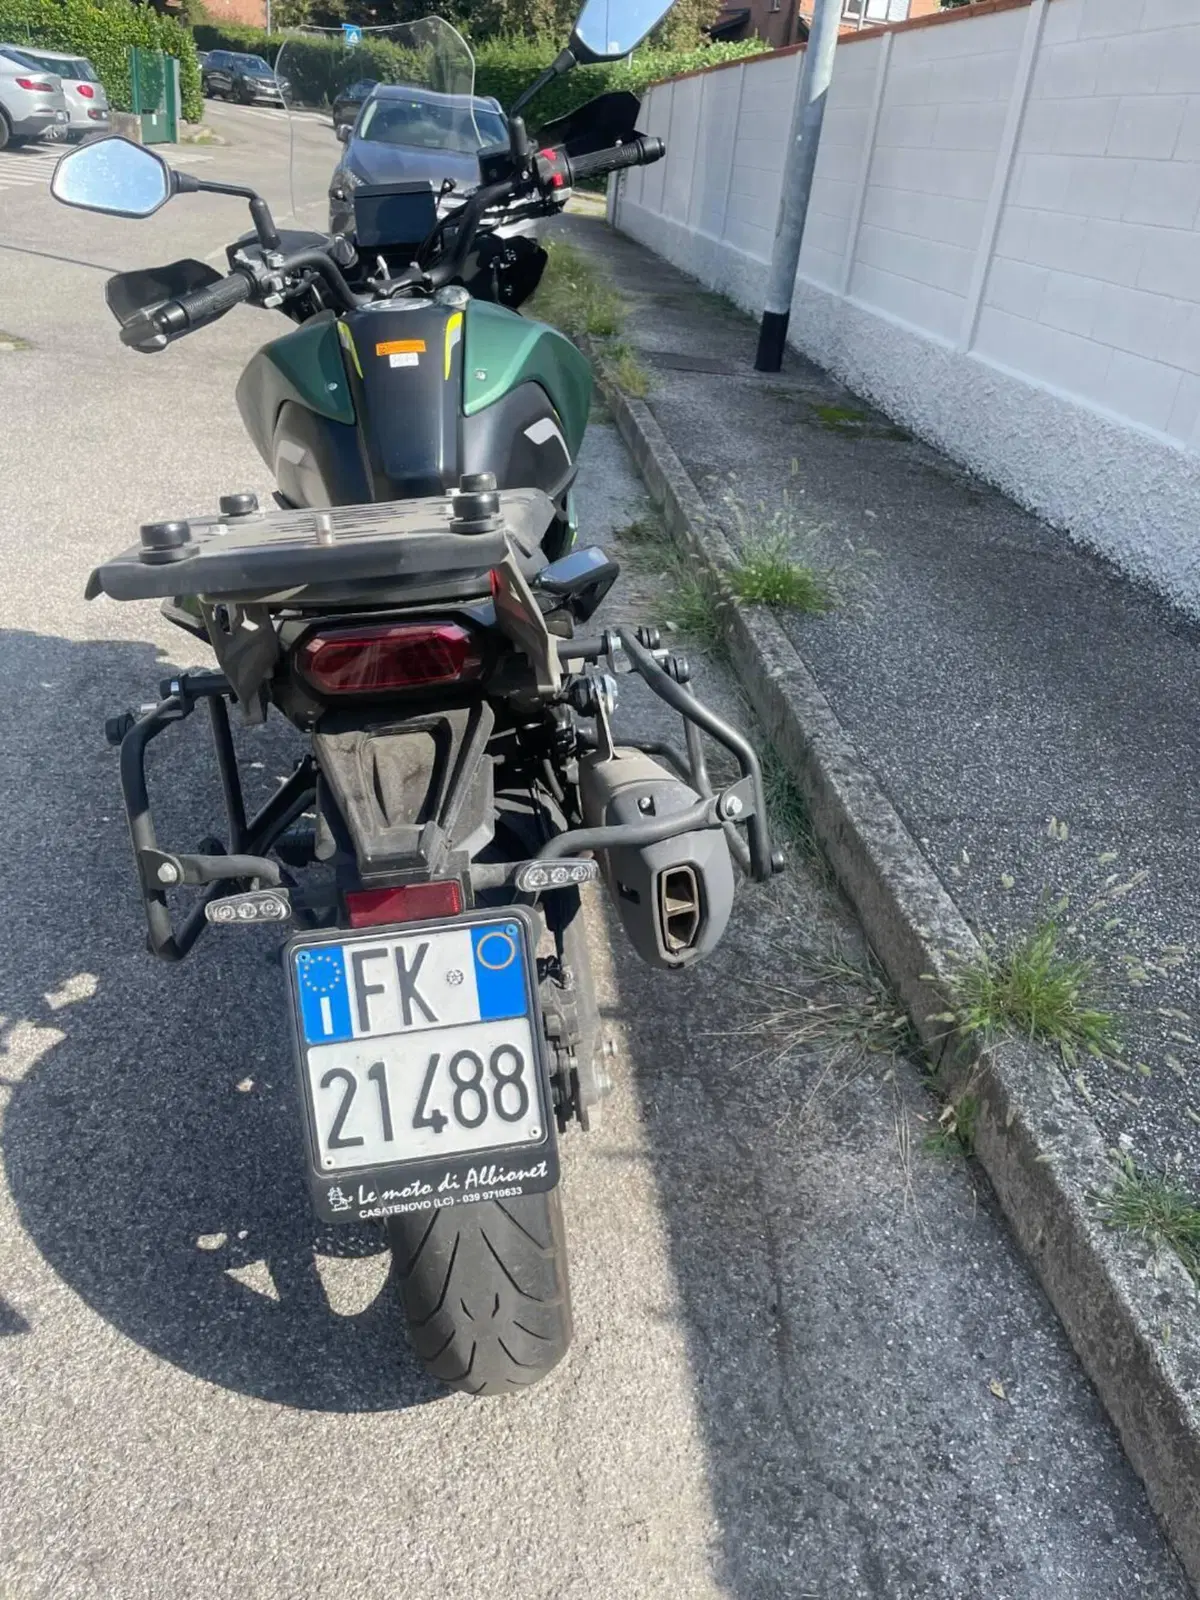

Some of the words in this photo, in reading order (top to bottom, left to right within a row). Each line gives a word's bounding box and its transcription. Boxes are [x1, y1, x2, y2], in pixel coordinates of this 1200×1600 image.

[351, 941, 439, 1032] FK
[319, 996, 334, 1035] I
[319, 1043, 530, 1150] 21488
[358, 1184, 377, 1205] Le
[381, 1179, 433, 1200] moto
[437, 1172, 460, 1192] di
[464, 1160, 548, 1190] Albionet
[358, 1200, 431, 1218] CASATENOVO
[433, 1196, 454, 1209] (LC)
[462, 1192, 480, 1203] 039
[482, 1186, 523, 1200] 9710633
